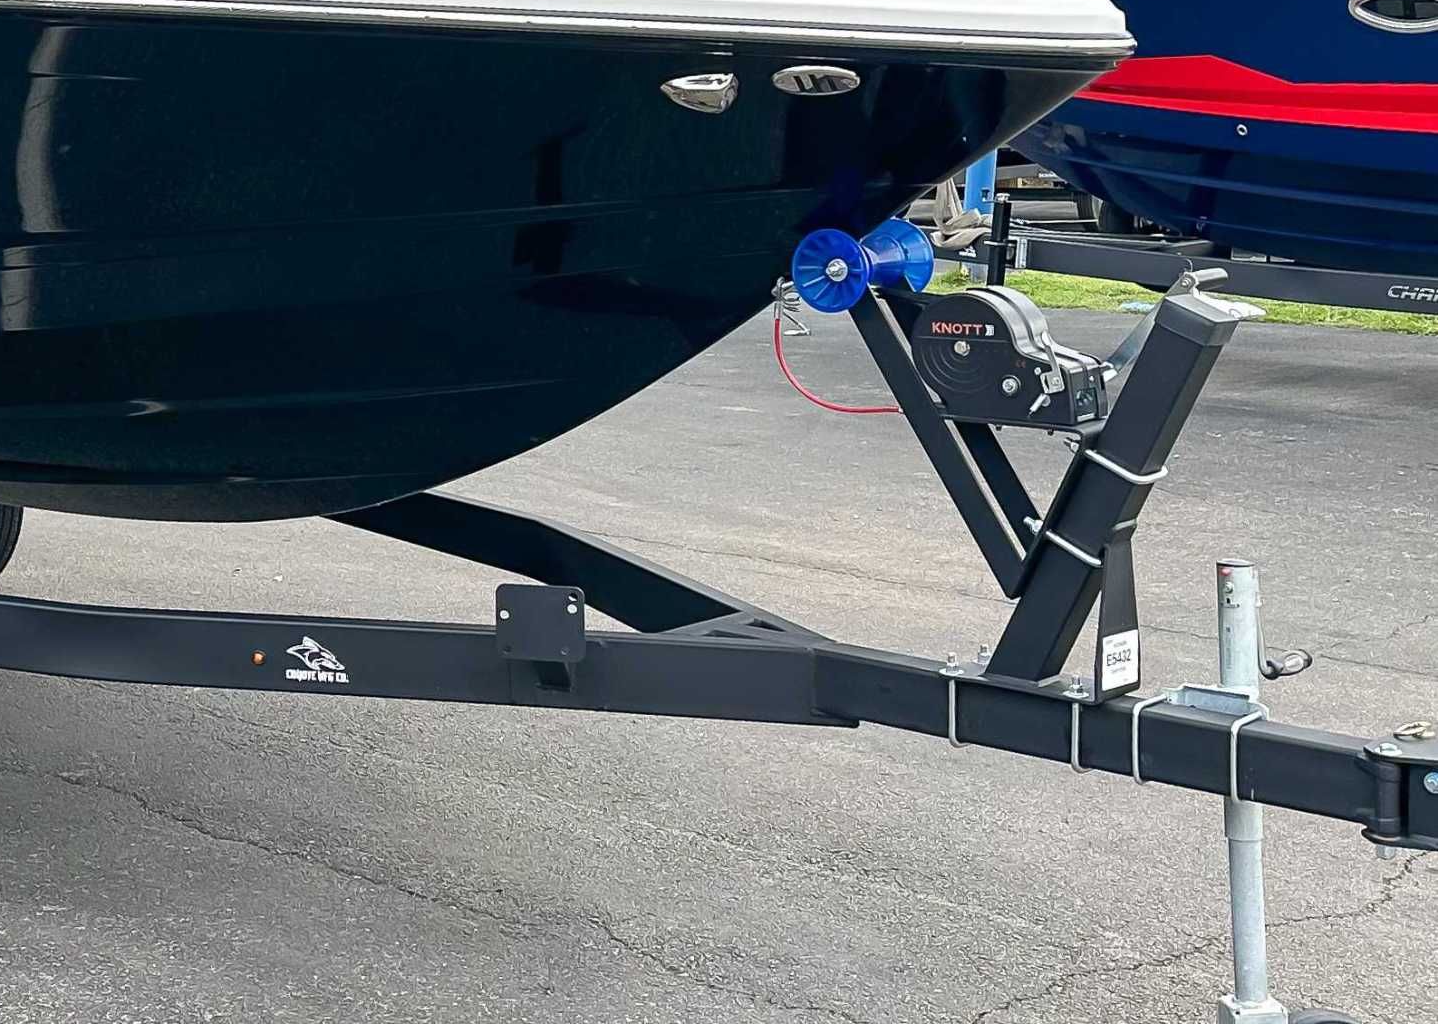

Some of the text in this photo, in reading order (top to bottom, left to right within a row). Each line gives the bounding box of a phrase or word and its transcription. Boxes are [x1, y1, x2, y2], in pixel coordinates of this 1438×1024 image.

[1387, 285, 1438, 302] CHA
[931, 322, 983, 335] KNOTT
[1106, 648, 1132, 667] E5432
